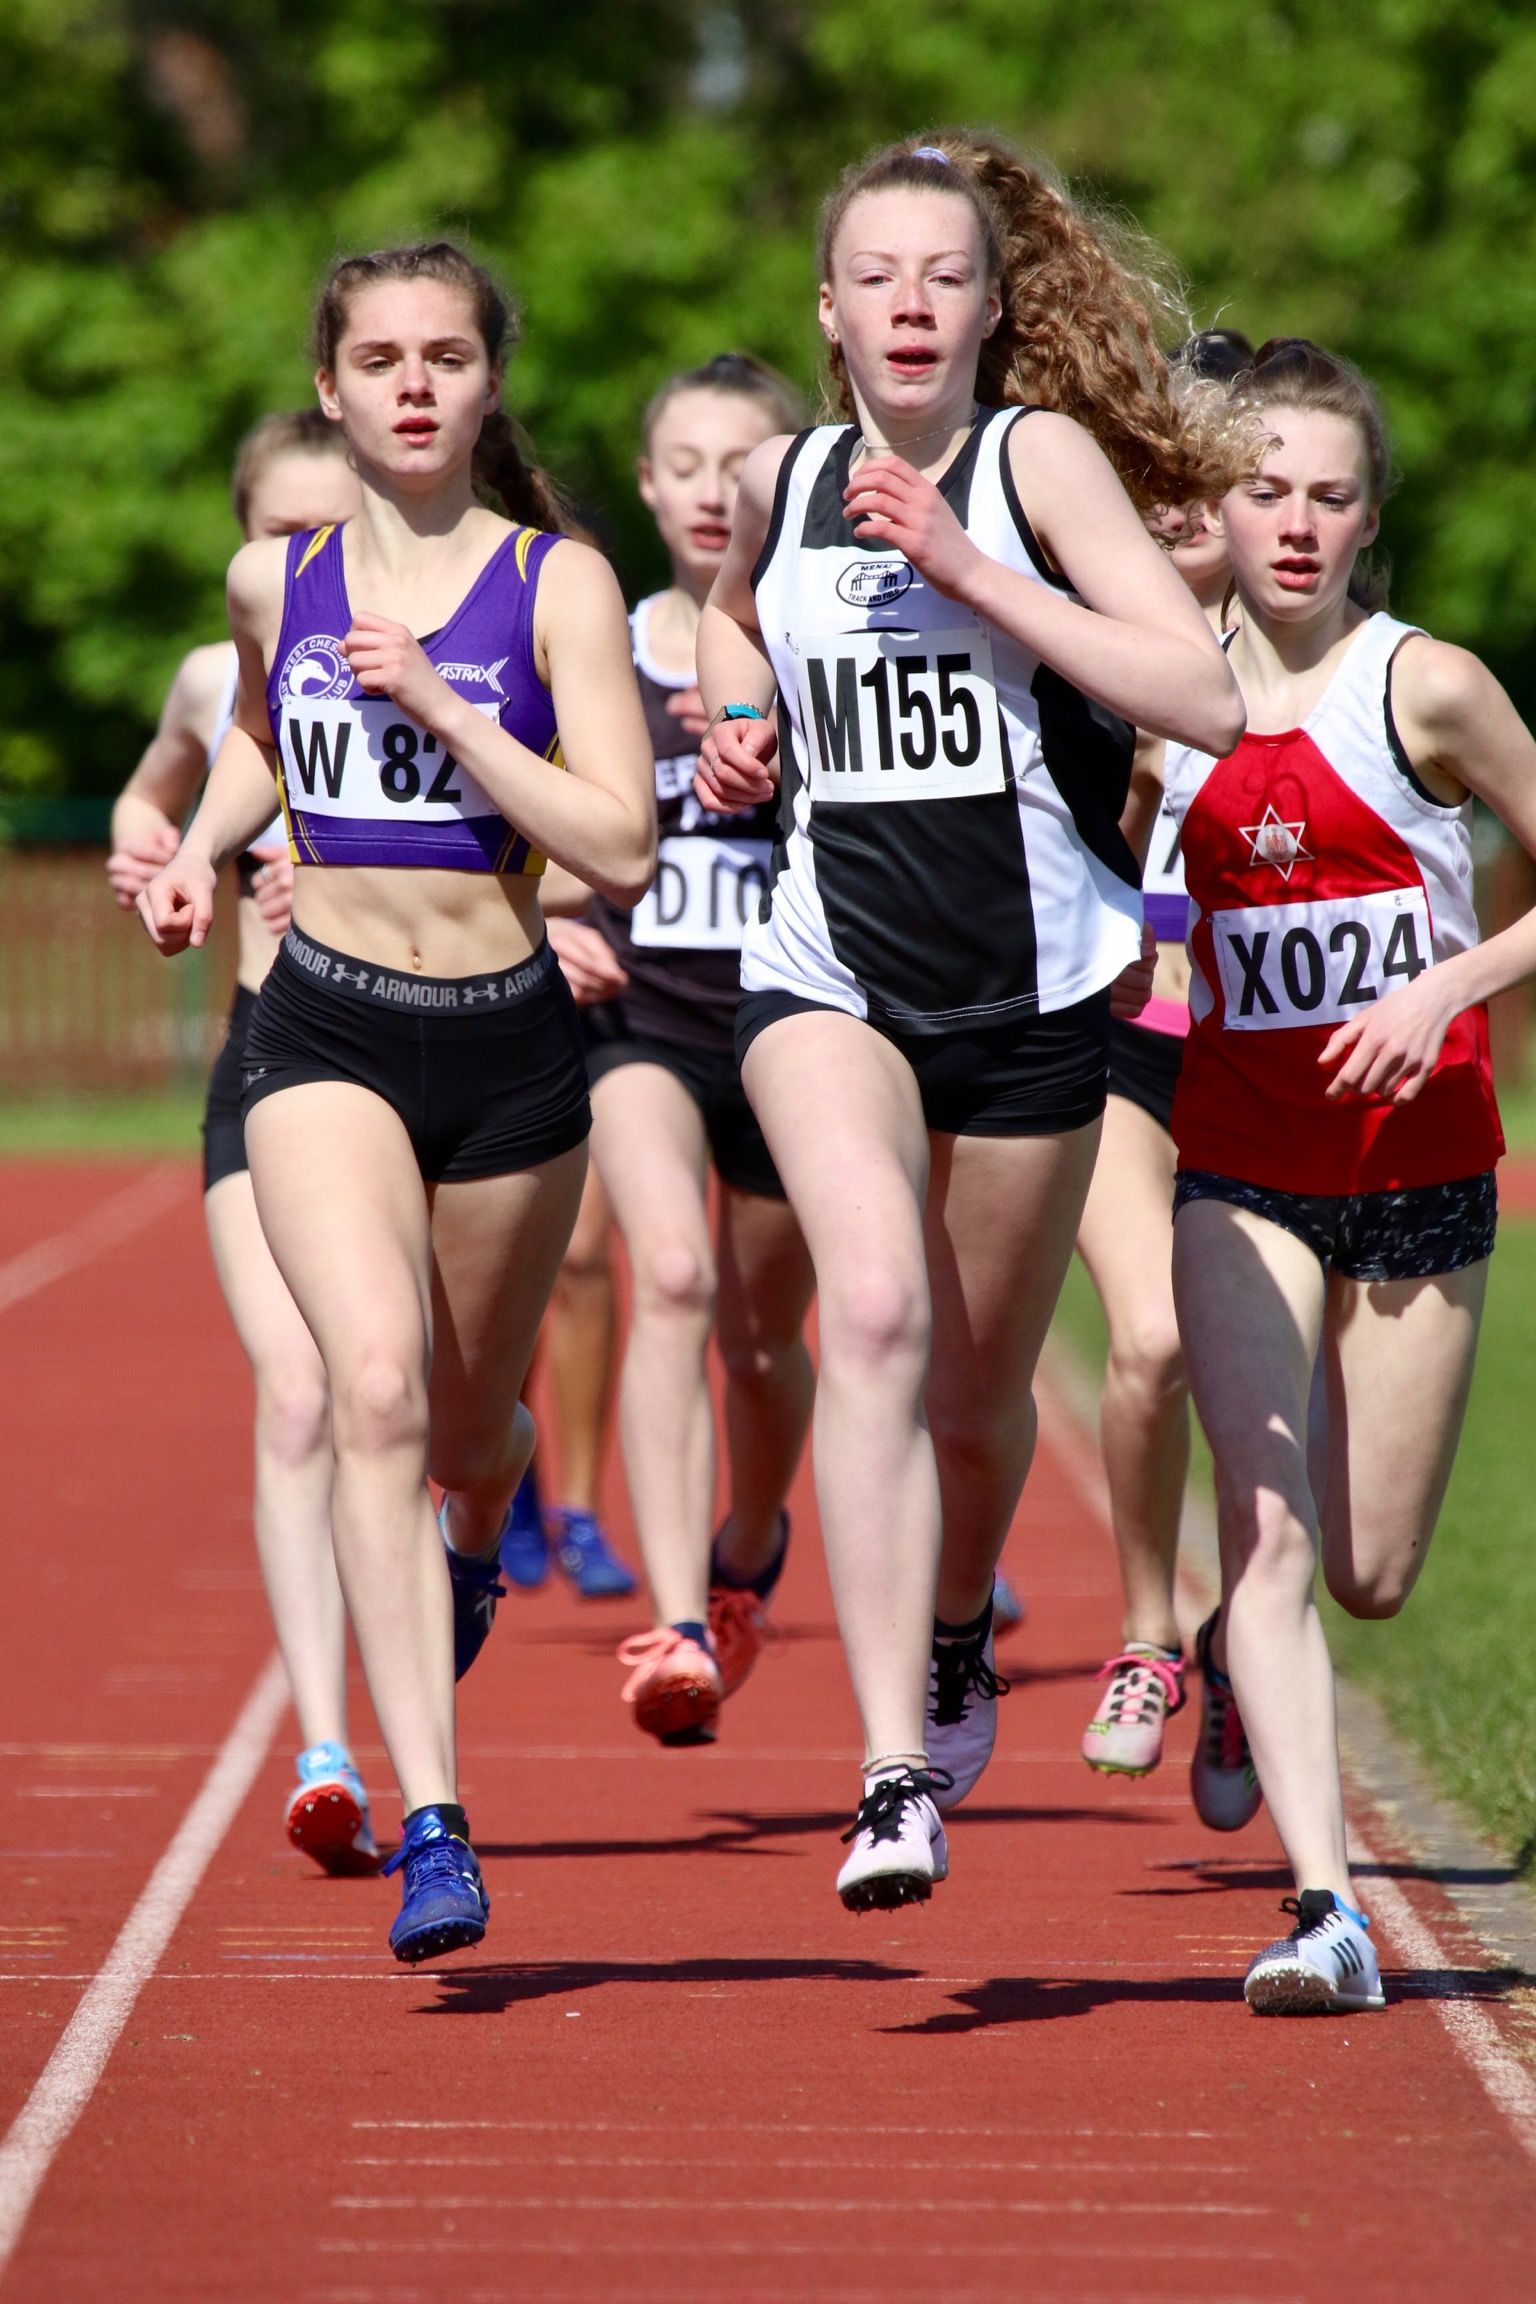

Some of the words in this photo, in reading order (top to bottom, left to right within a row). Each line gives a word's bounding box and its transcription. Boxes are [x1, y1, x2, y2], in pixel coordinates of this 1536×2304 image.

[848, 594, 867, 602] TRACK
[869, 594, 881, 602] AND
[883, 588, 900, 600] FIELD
[284, 644, 306, 673] WEST
[309, 638, 351, 672] CHESRE
[807, 653, 982, 773] M155
[289, 718, 352, 799] W
[379, 723, 462, 804] 82
[285, 926, 331, 978] RMOUR
[371, 975, 458, 1008] ARMOUR
[1227, 912, 1427, 1017] X024
